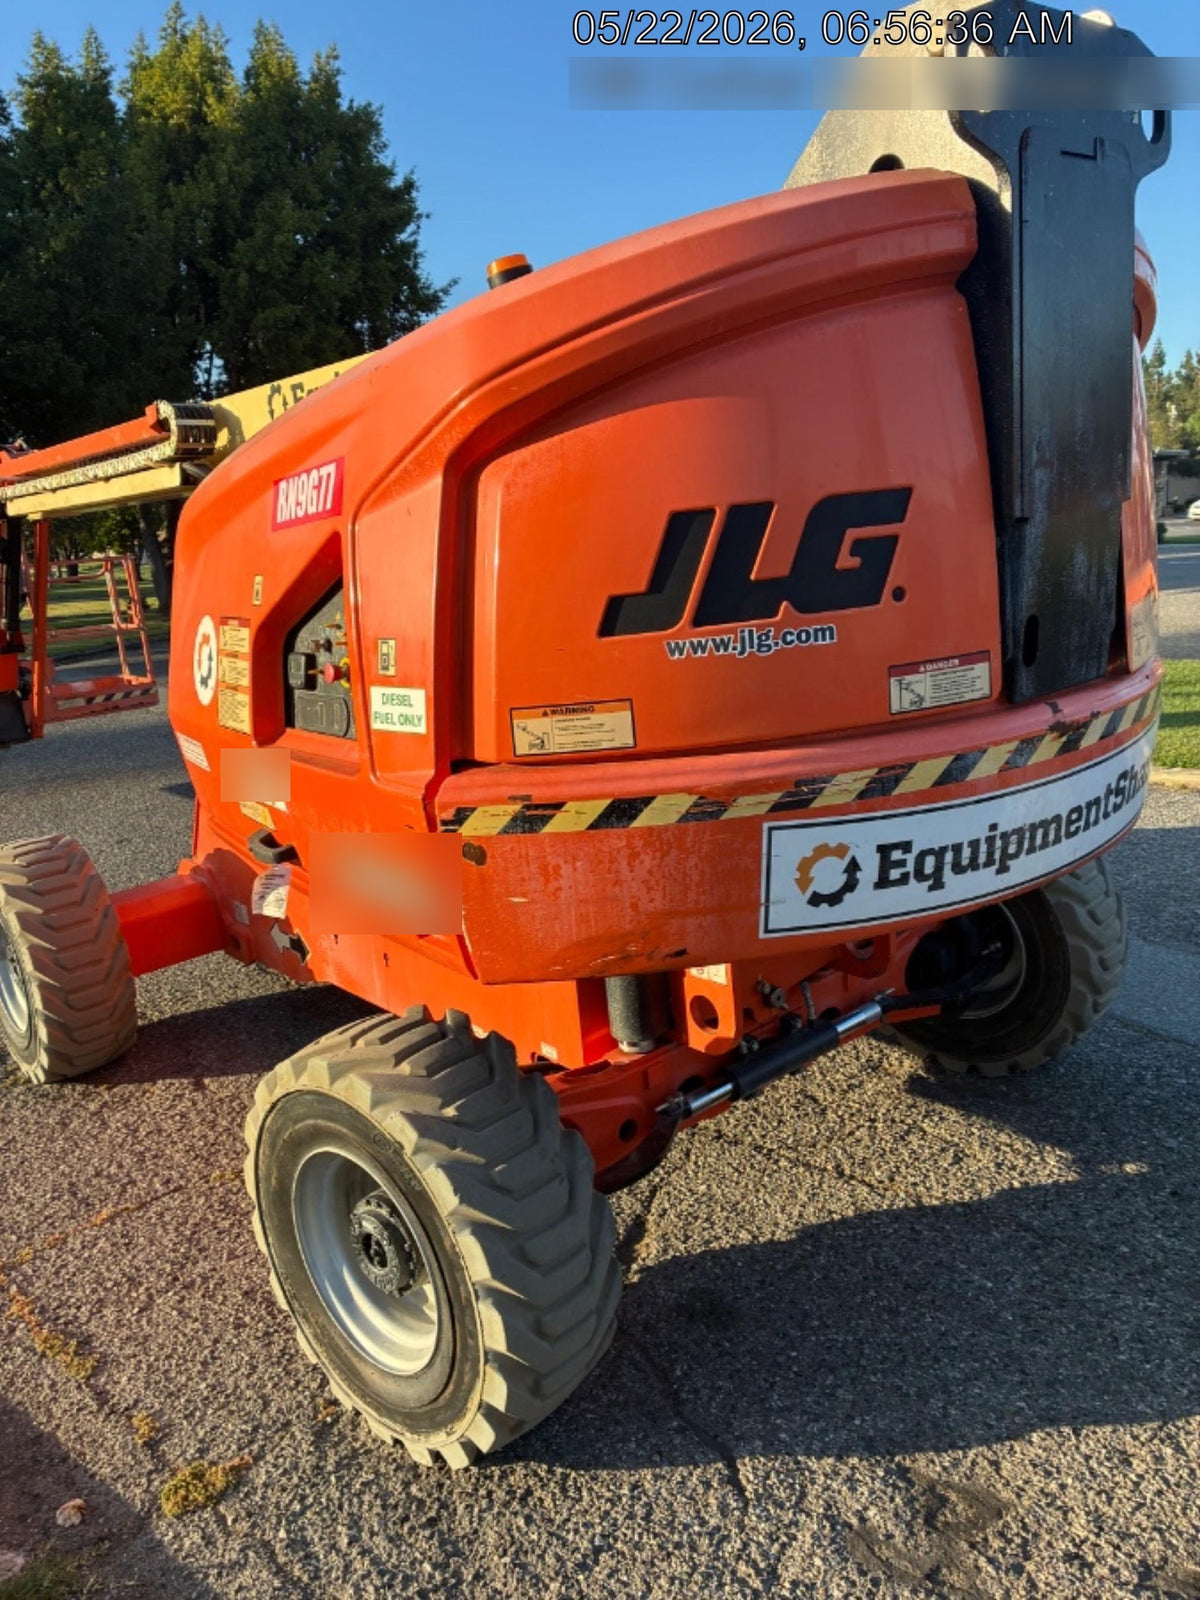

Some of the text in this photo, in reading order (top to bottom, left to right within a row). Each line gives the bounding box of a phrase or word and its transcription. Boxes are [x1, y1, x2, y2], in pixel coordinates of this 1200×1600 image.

[666, 624, 836, 658] www.jlg.com
[926, 659, 960, 671] DANGER
[381, 693, 413, 707] DIESEL
[550, 705, 595, 716] WARNING
[373, 711, 422, 728] FUEL ONLY
[873, 761, 1149, 892] EquipmentSha
